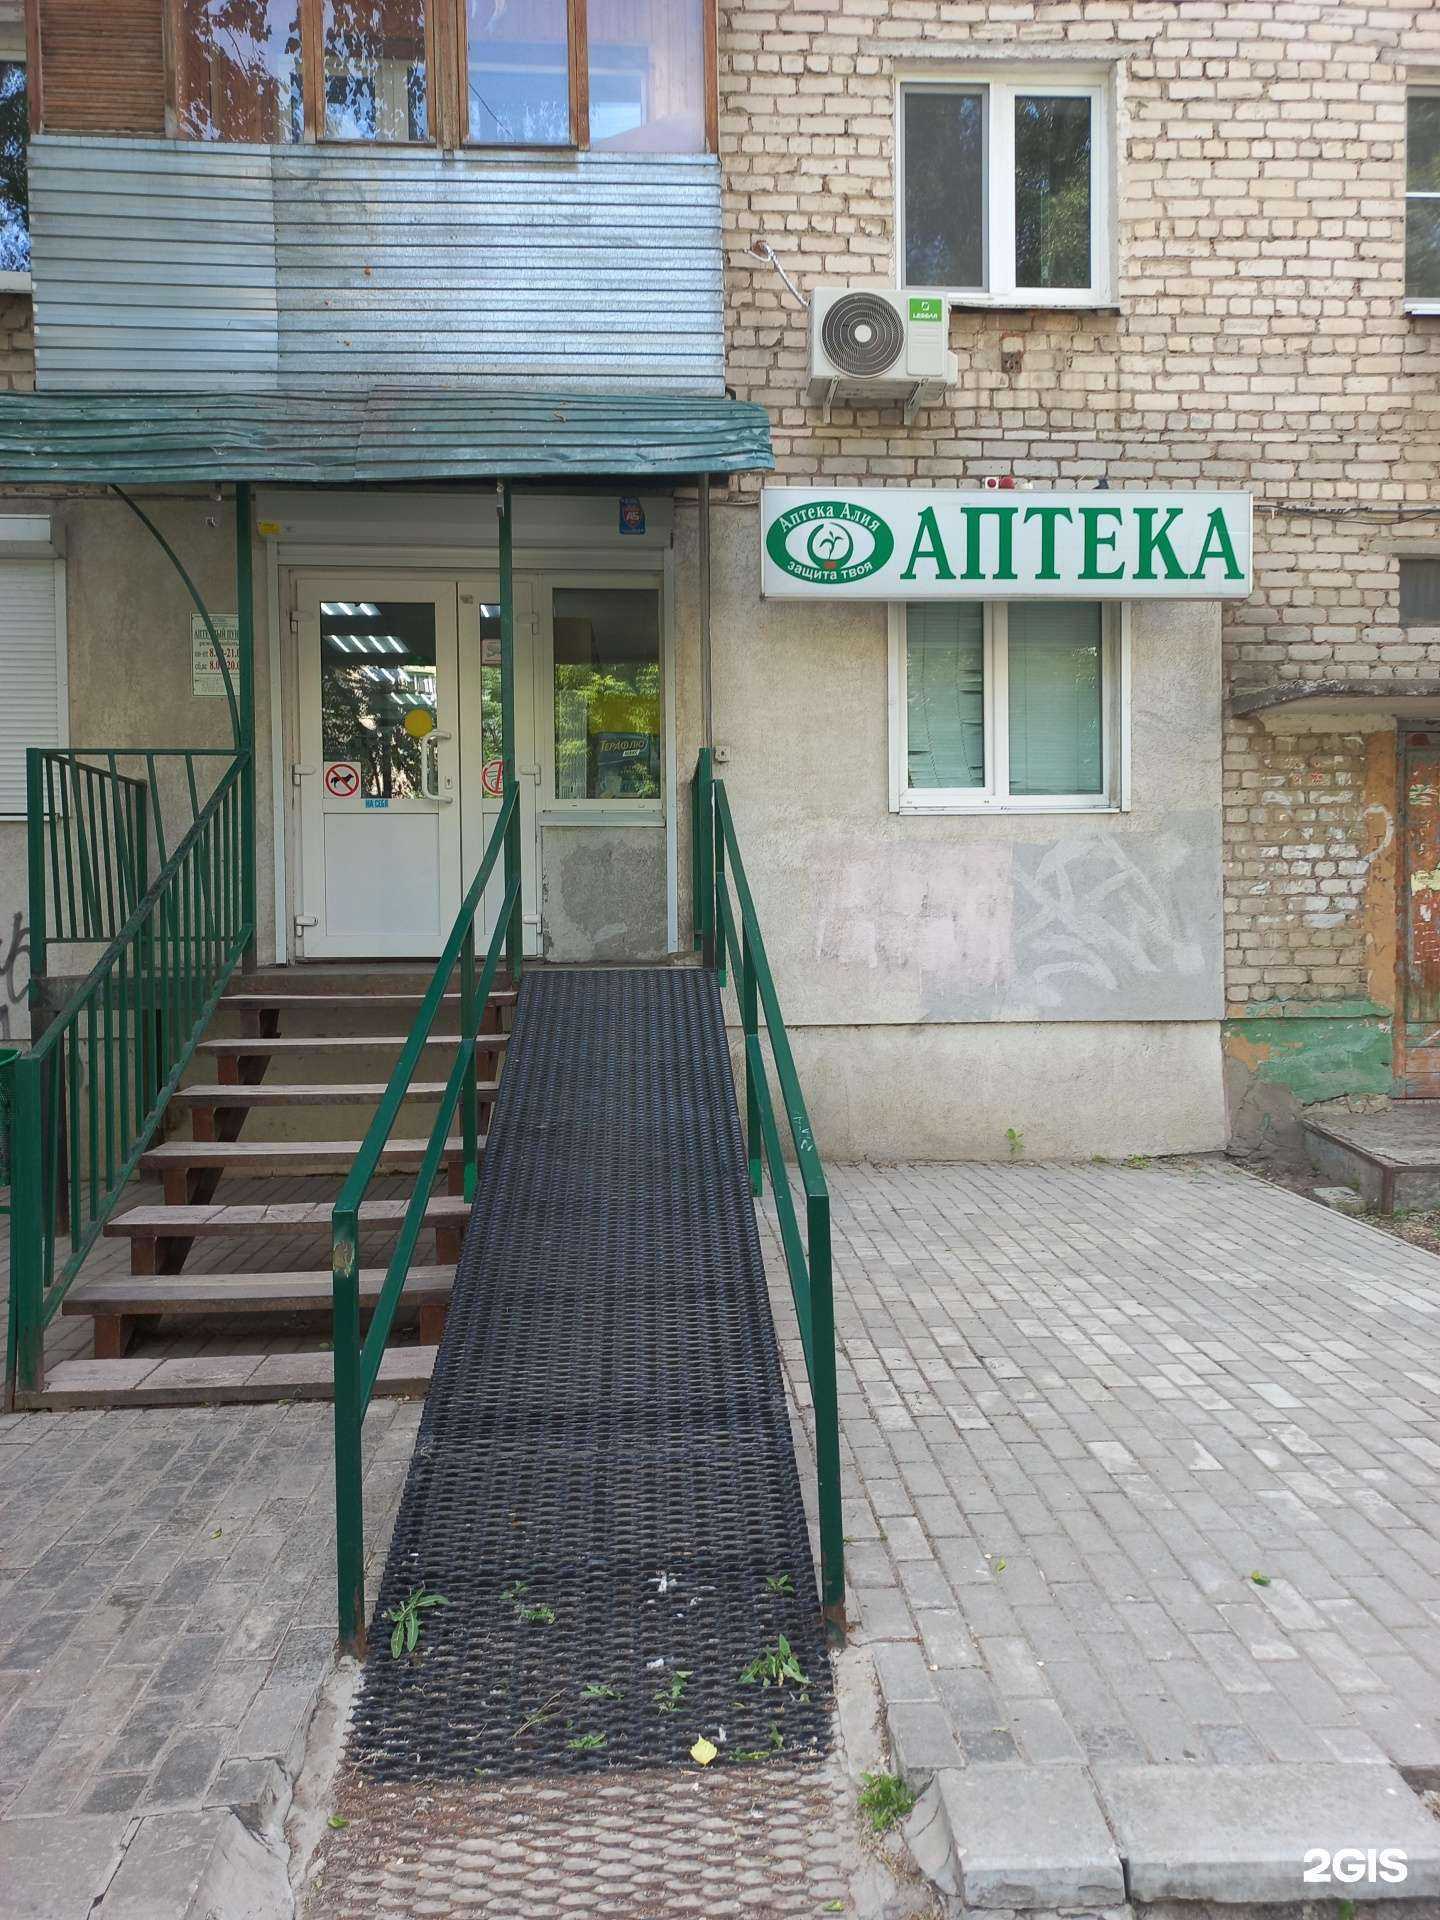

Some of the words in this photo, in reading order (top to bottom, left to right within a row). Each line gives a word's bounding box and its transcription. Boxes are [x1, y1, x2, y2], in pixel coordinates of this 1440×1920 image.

[779, 505, 834, 533] Аптека
[840, 503, 881, 532] Алия
[899, 505, 1245, 580] АПТЕКА
[787, 561, 838, 580] защита
[841, 561, 873, 579] твоя
